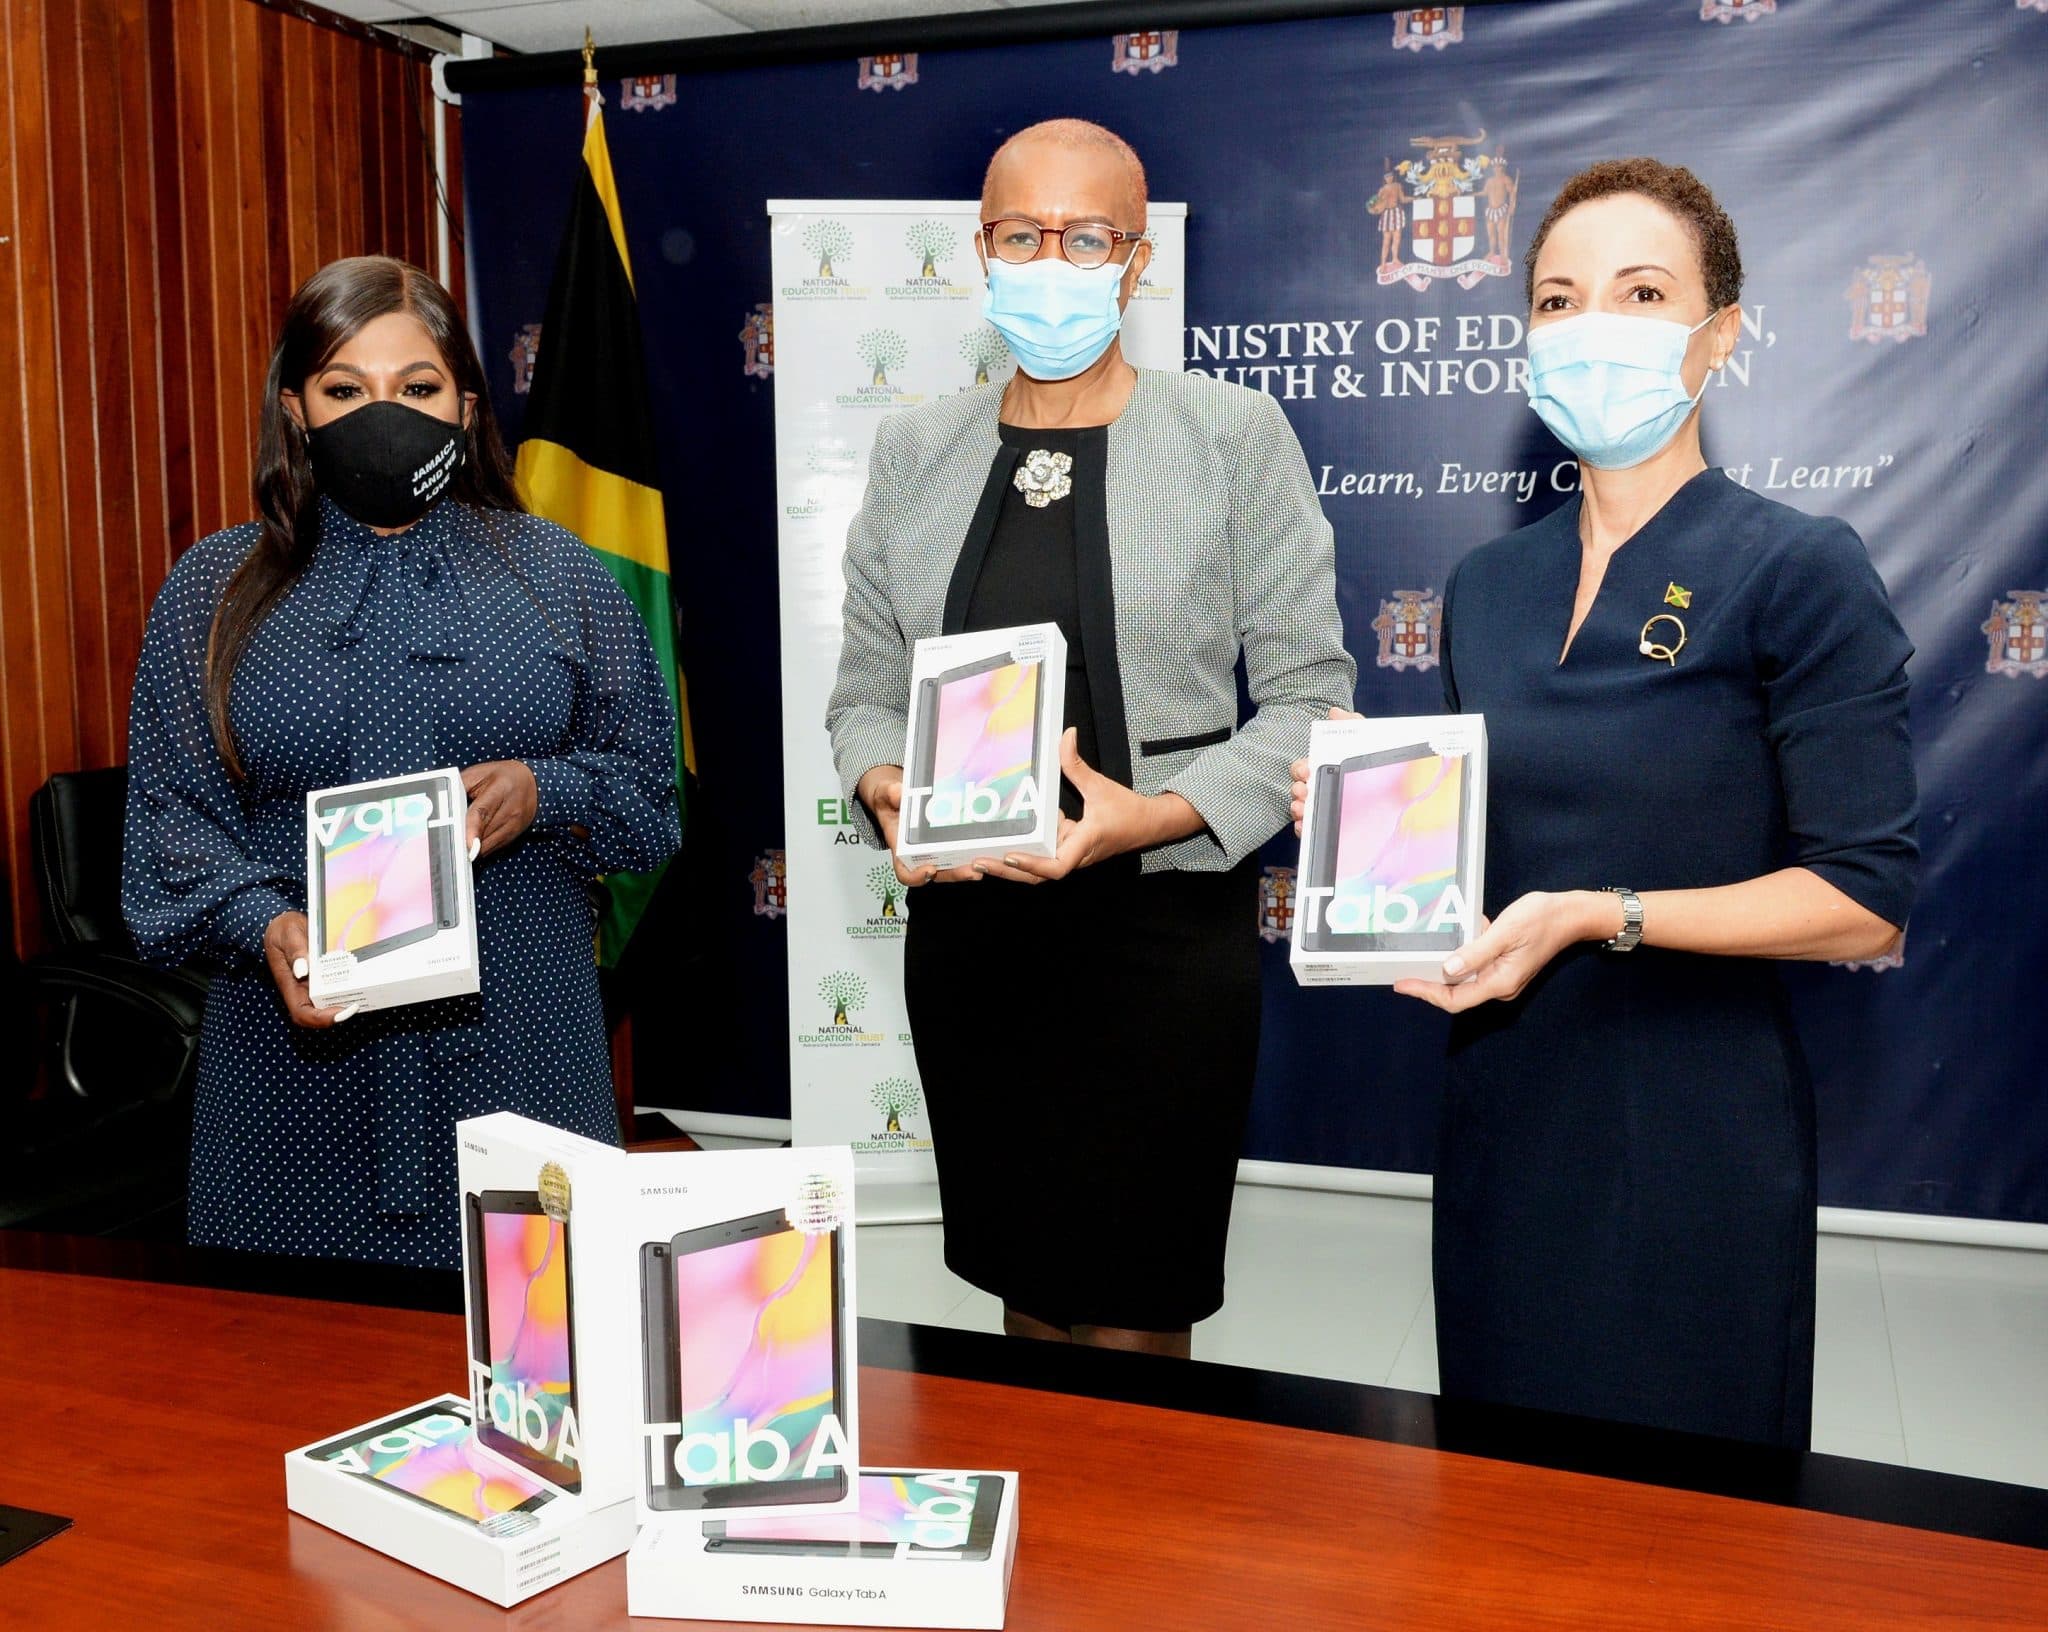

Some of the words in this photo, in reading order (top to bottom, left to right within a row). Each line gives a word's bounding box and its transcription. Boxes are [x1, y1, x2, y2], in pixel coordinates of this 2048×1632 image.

[782, 287, 837, 295] EDUCATION
[885, 287, 939, 295] EDUCATION
[906, 278, 952, 286] NATIONAL
[1184, 320, 1363, 361] NISTRY
[1375, 317, 1441, 354] OF
[857, 386, 904, 394] NATIONAL
[1331, 364, 1368, 399] &
[836, 395, 891, 403] EDUCATION
[412, 438, 455, 482] JAMAICA
[413, 469, 443, 496] LAND
[444, 450, 457, 470] WE
[1765, 455, 1894, 489] Learn”
[425, 472, 450, 502] LOVE
[1317, 465, 1423, 499] Learn,
[1436, 463, 1537, 502] Every
[354, 790, 454, 836] Tab
[905, 782, 1000, 829] Tab
[1007, 775, 1041, 820] A
[313, 807, 347, 846] A
[866, 917, 907, 926] NATIONA
[1302, 885, 1419, 934] Tab
[1427, 884, 1467, 933] A
[846, 926, 901, 935] EDUCATION
[798, 1034, 852, 1043] EDUCATION
[855, 1033, 885, 1042] TRUST
[818, 1026, 864, 1034] NATIONAL
[463, 1141, 488, 1155] SAMSUNG
[851, 1140, 904, 1149] EDUCATION
[907, 1139, 932, 1148] TRUS
[871, 1132, 917, 1140] NATIONAL
[640, 1187, 689, 1195] SAMSUNG
[471, 1358, 549, 1453] Tab
[556, 1404, 581, 1470] A
[324, 1445, 371, 1475] A
[639, 1417, 790, 1487] Tab
[800, 1413, 850, 1480] A
[915, 1471, 980, 1494] A
[892, 1495, 976, 1560] Tab
[742, 1585, 804, 1597] SAMSUNG
[808, 1587, 852, 1600] Galaxy
[855, 1589, 877, 1599] Tab
[878, 1589, 887, 1599] A
